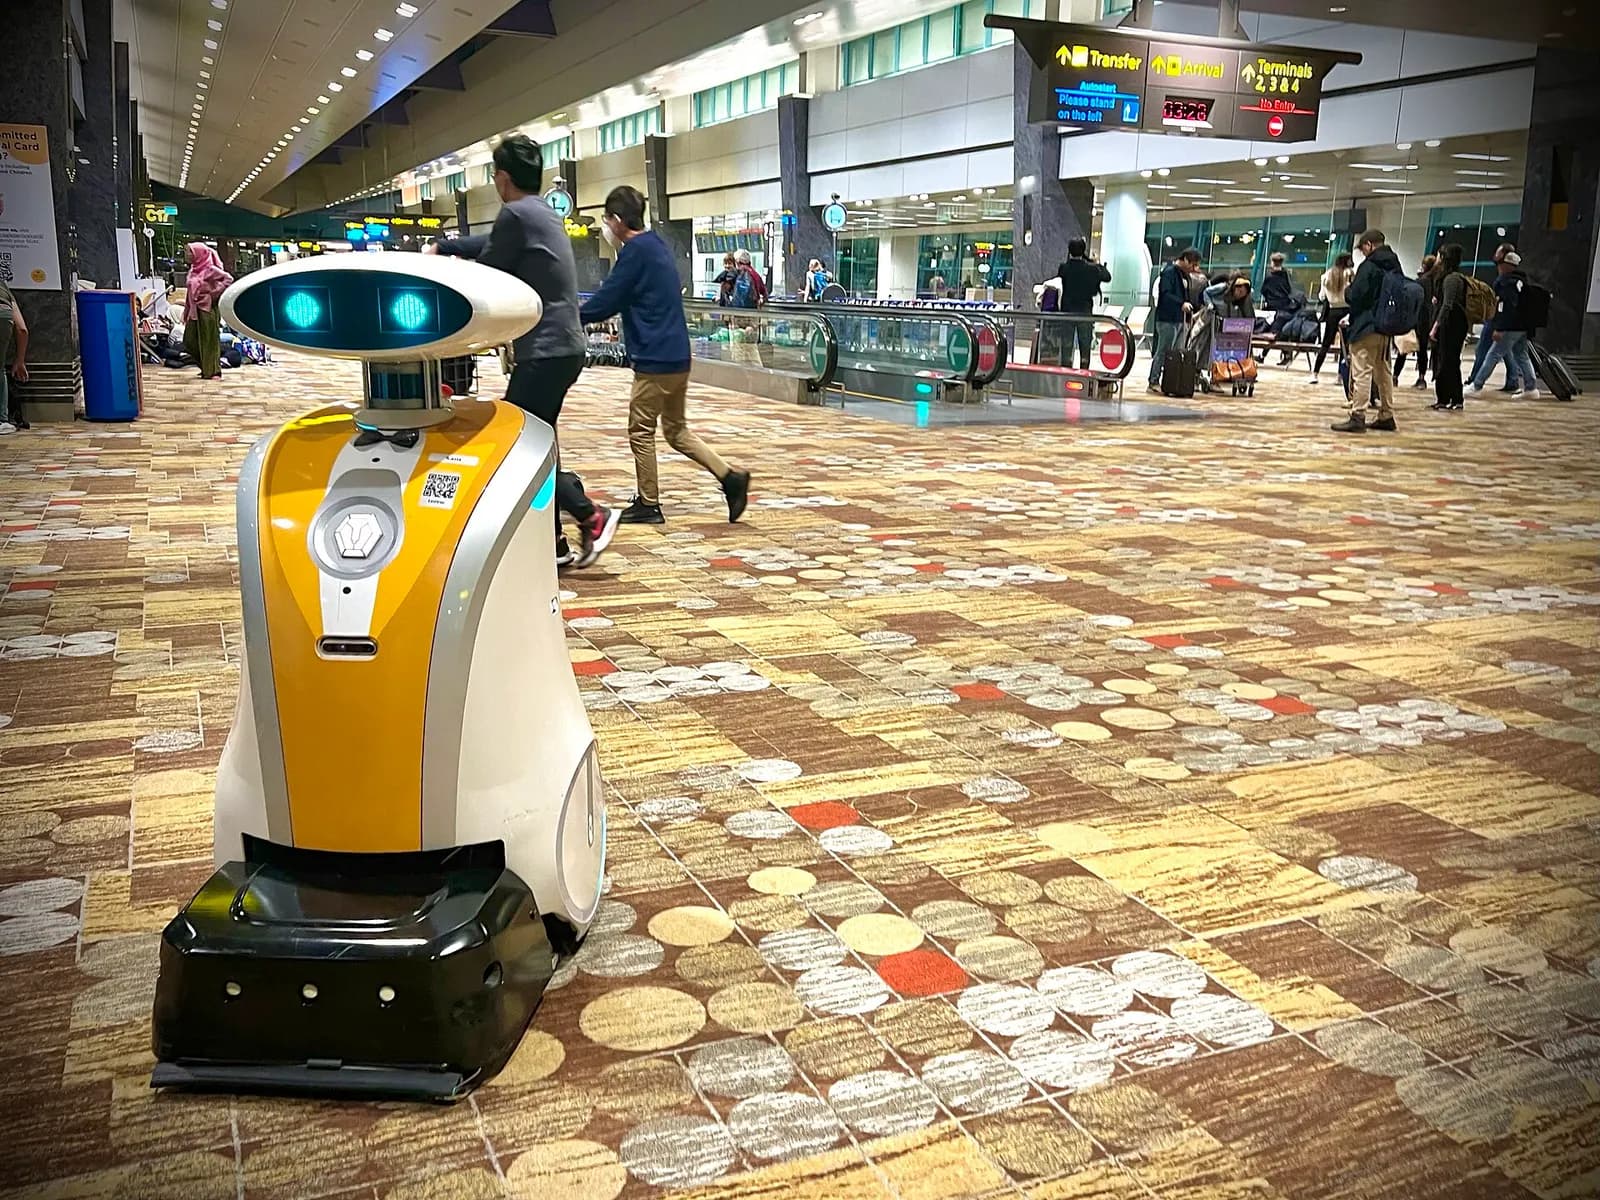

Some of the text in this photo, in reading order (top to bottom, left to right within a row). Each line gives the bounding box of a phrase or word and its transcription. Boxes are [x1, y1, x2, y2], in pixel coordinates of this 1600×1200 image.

[1090, 49, 1142, 71] Transfer
[1182, 61, 1225, 79] Arrival
[1257, 58, 1313, 79] Terminals
[1255, 75, 1300, 93] 2, 3 & 4
[1059, 93, 1115, 109] Please stand
[1260, 98, 1296, 112] No Entry
[1058, 109, 1103, 122] on the left
[0, 131, 37, 140] mitted
[14, 142, 39, 151] Card
